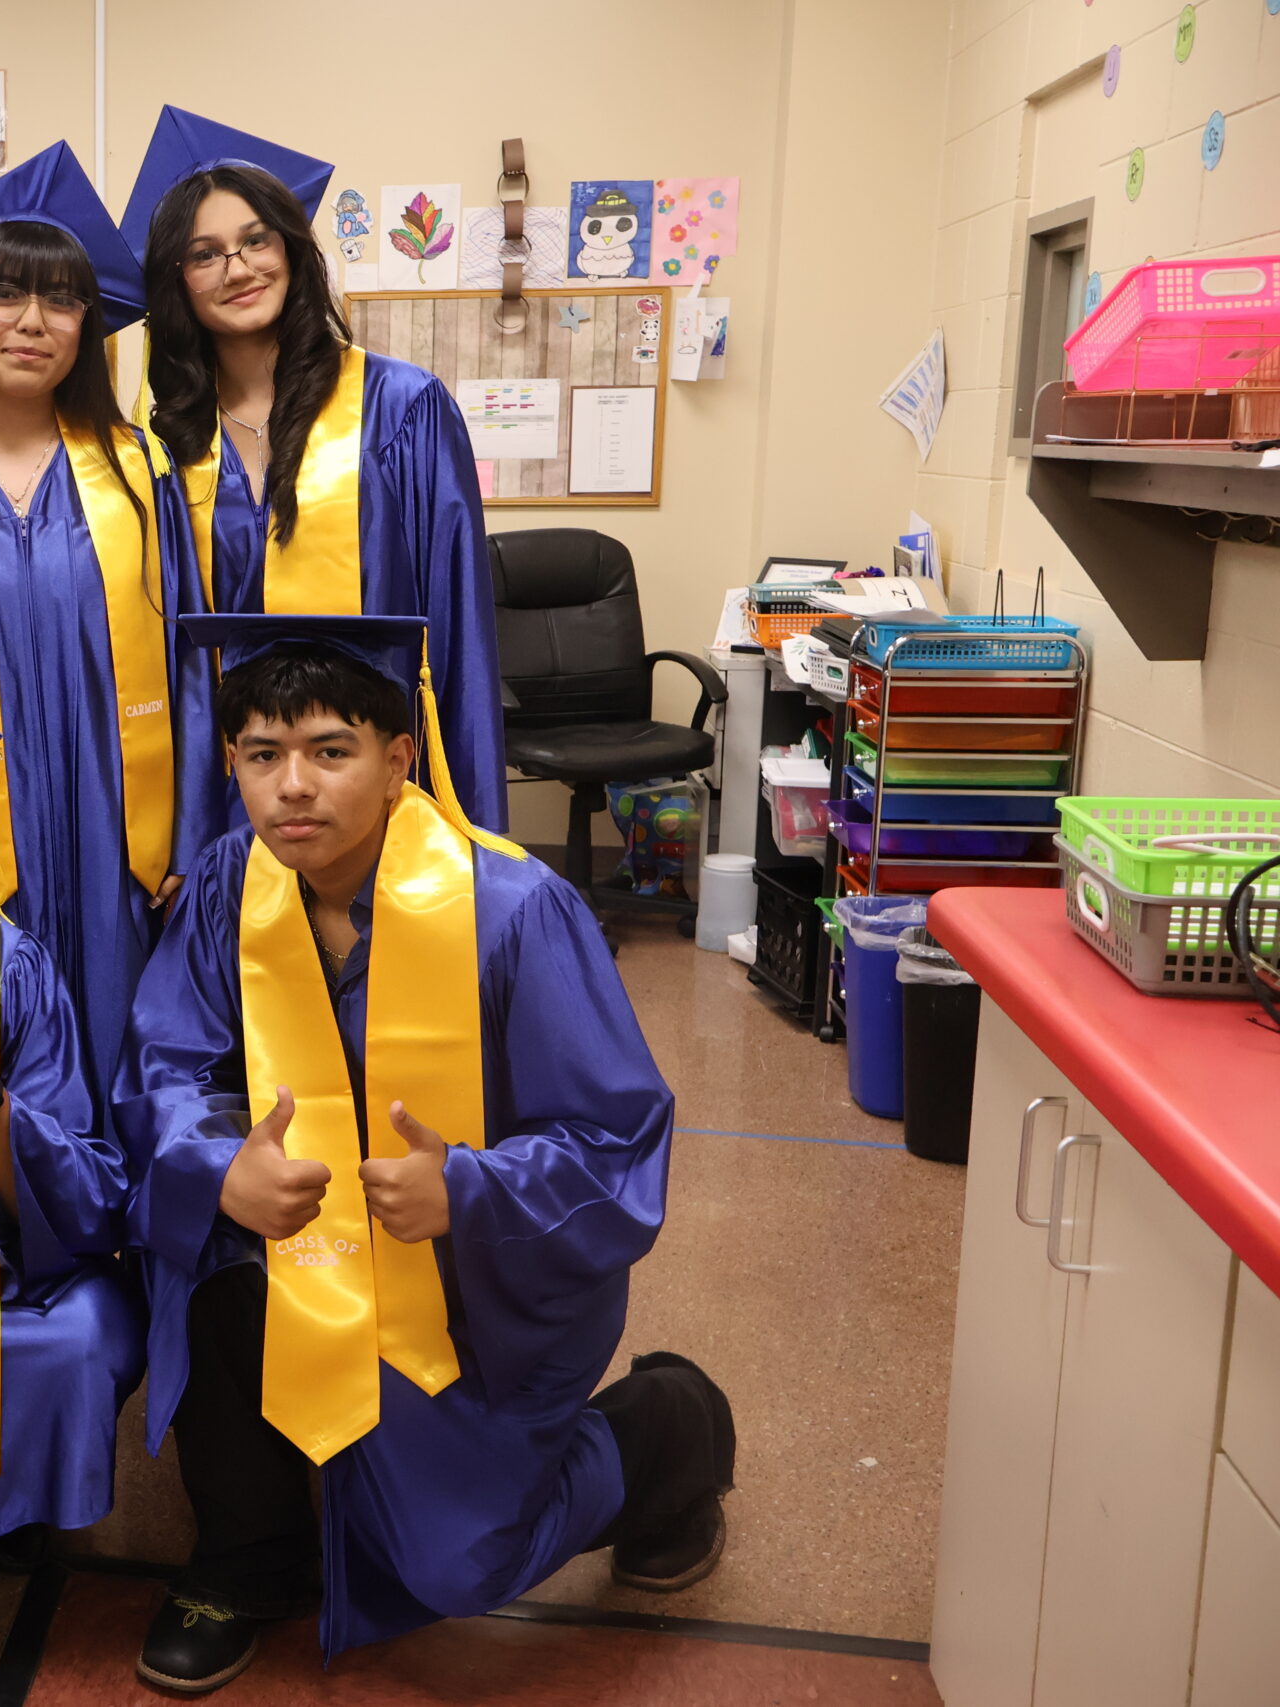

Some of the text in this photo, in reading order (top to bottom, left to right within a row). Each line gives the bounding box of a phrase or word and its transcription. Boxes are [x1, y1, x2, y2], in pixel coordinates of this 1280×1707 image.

[125, 699, 163, 718] CARMEN
[275, 1235, 360, 1255] CLASS OF
[294, 1252, 339, 1267] 2026
